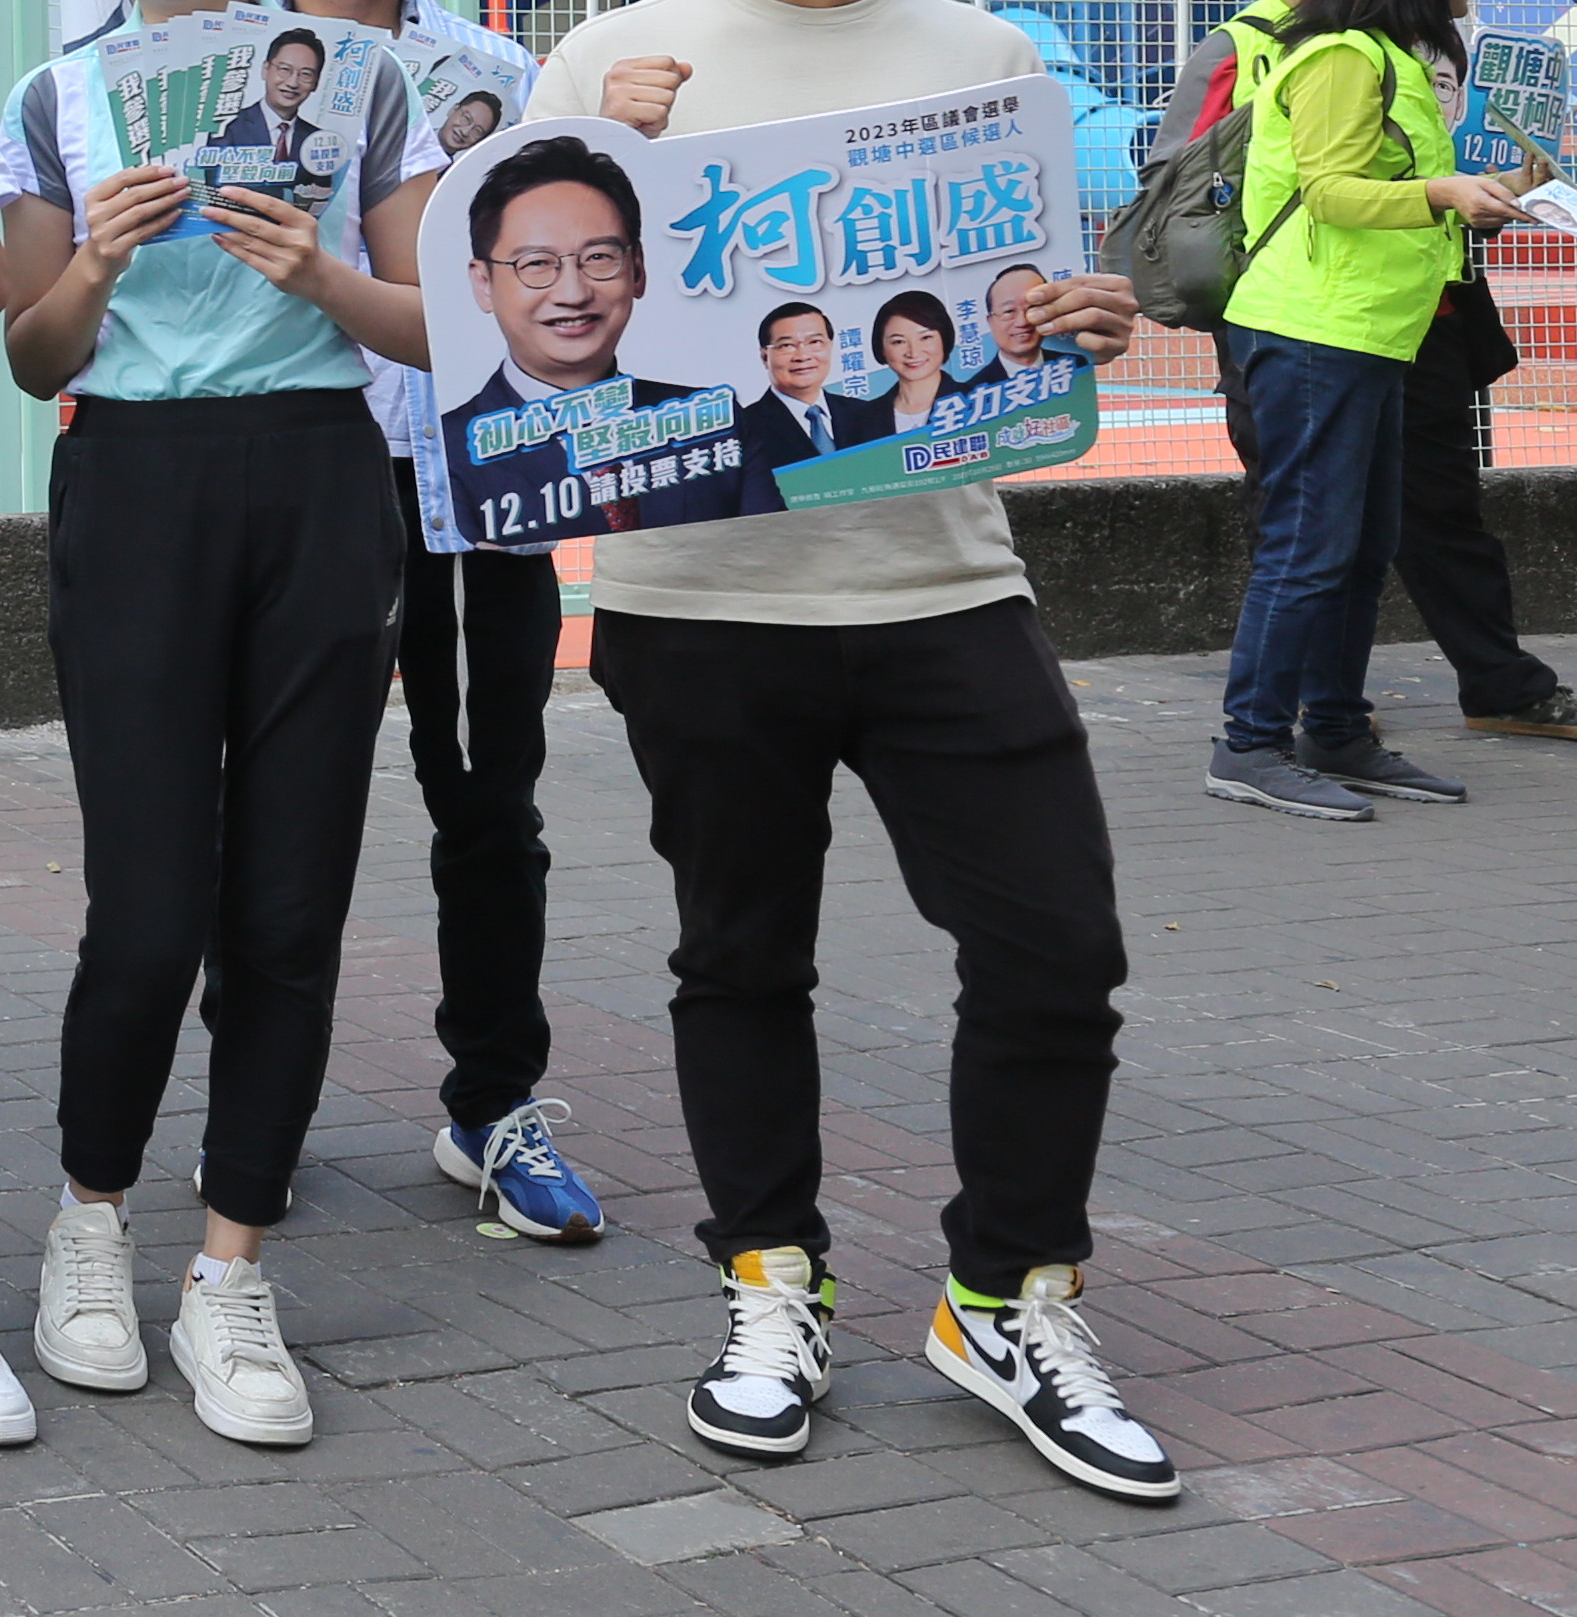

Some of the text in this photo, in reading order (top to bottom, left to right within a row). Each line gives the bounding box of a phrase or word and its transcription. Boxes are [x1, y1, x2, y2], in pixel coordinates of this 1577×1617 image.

[334, 32, 374, 113] 柯創盛
[1478, 40, 1564, 90] 觀塘中
[314, 138, 338, 147] 12.10
[845, 96, 1020, 144] 2023年區議會選舉
[847, 119, 1023, 167] 觀塘中選區候選人
[199, 148, 275, 165] 初心不變
[1464, 134, 1508, 165] 12.10
[671, 161, 1041, 288] 柯創盛
[839, 328, 870, 396] 譚耀宗
[476, 380, 633, 459] 初心不變
[933, 359, 1074, 435] 全力支持
[576, 390, 734, 468] 堅毅向前
[933, 433, 988, 459] 民建聯
[961, 453, 988, 463] DAB
[479, 476, 582, 541] 12.10
[590, 439, 743, 505] 請投票支持
